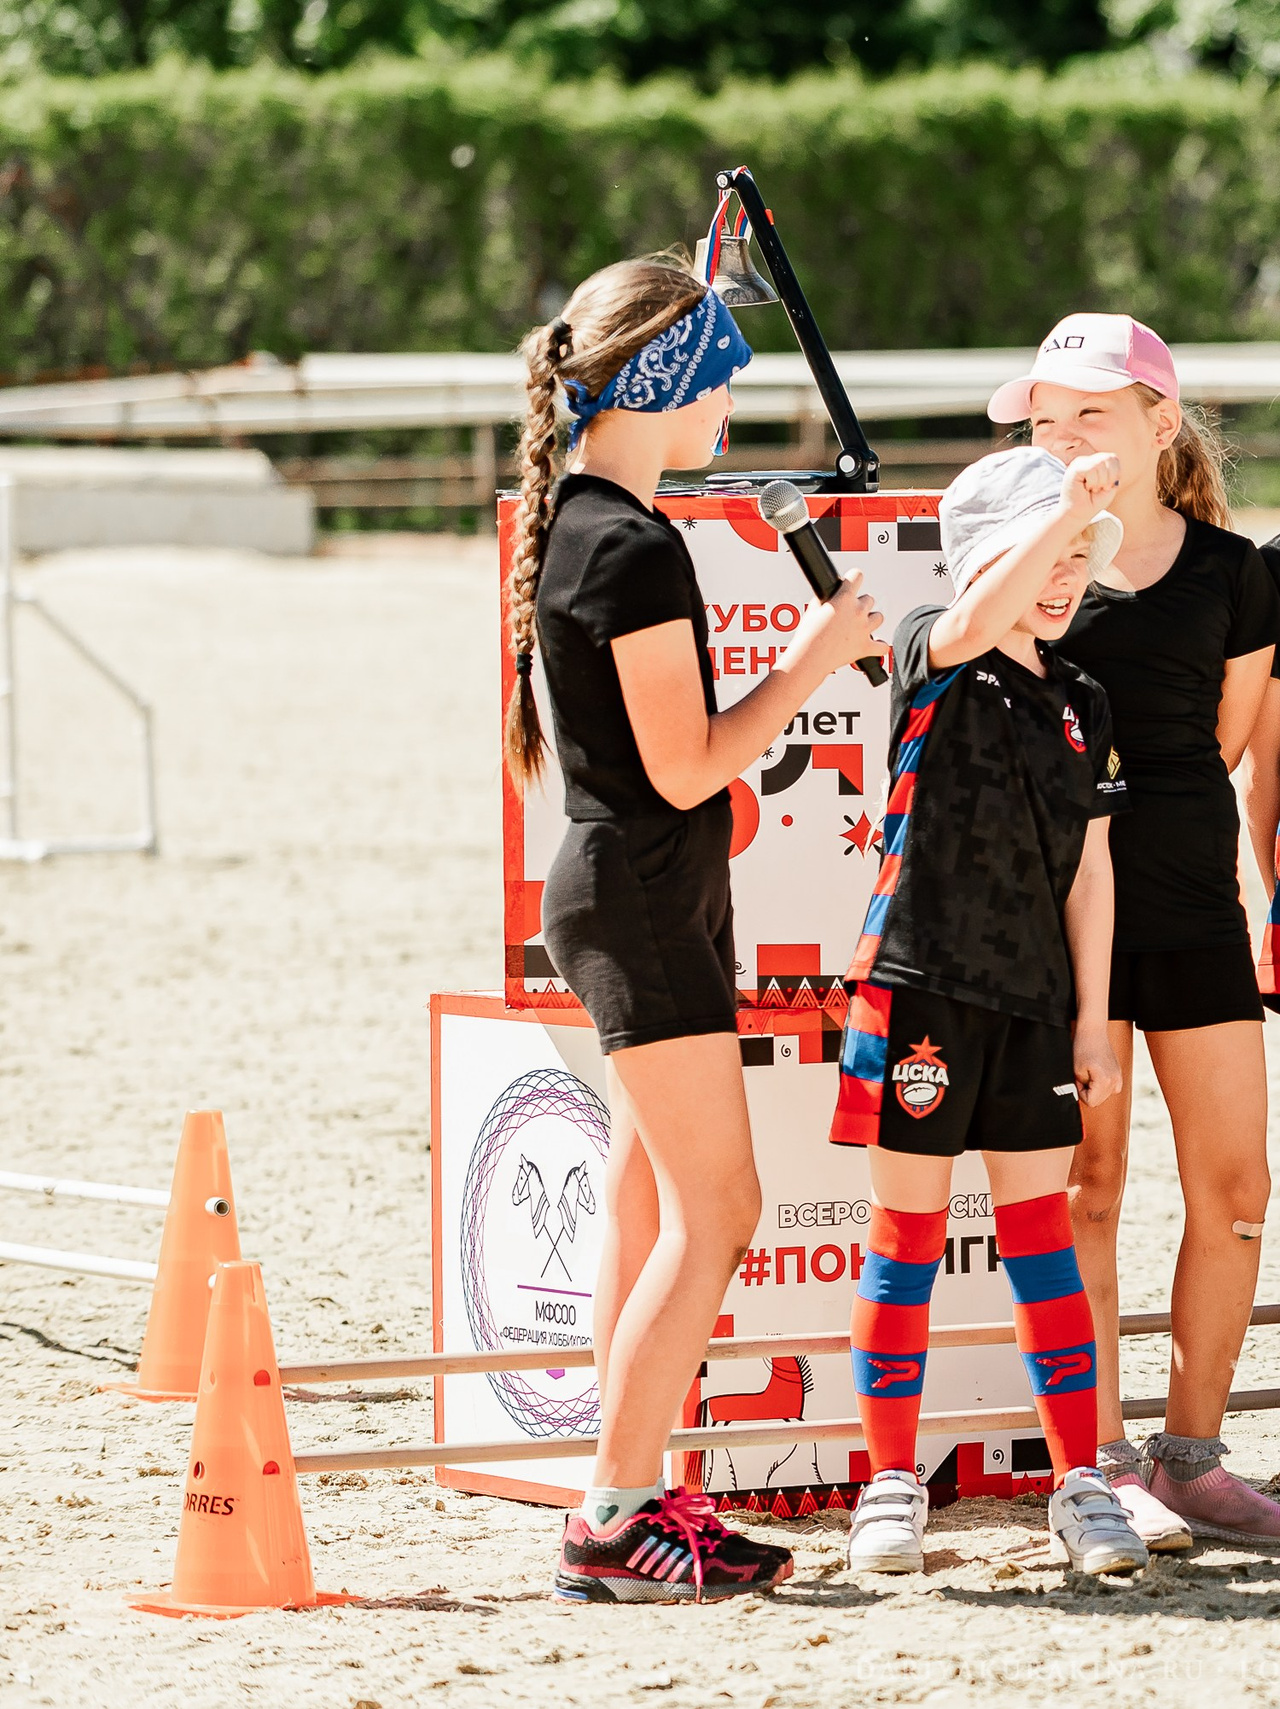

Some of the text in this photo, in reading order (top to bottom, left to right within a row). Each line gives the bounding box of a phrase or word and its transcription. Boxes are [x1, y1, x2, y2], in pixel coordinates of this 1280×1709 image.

[704, 603, 809, 633] УБО
[783, 711, 861, 736] лет
[891, 1063, 950, 1087] ЦСКА
[535, 1300, 577, 1326] МФСОО
